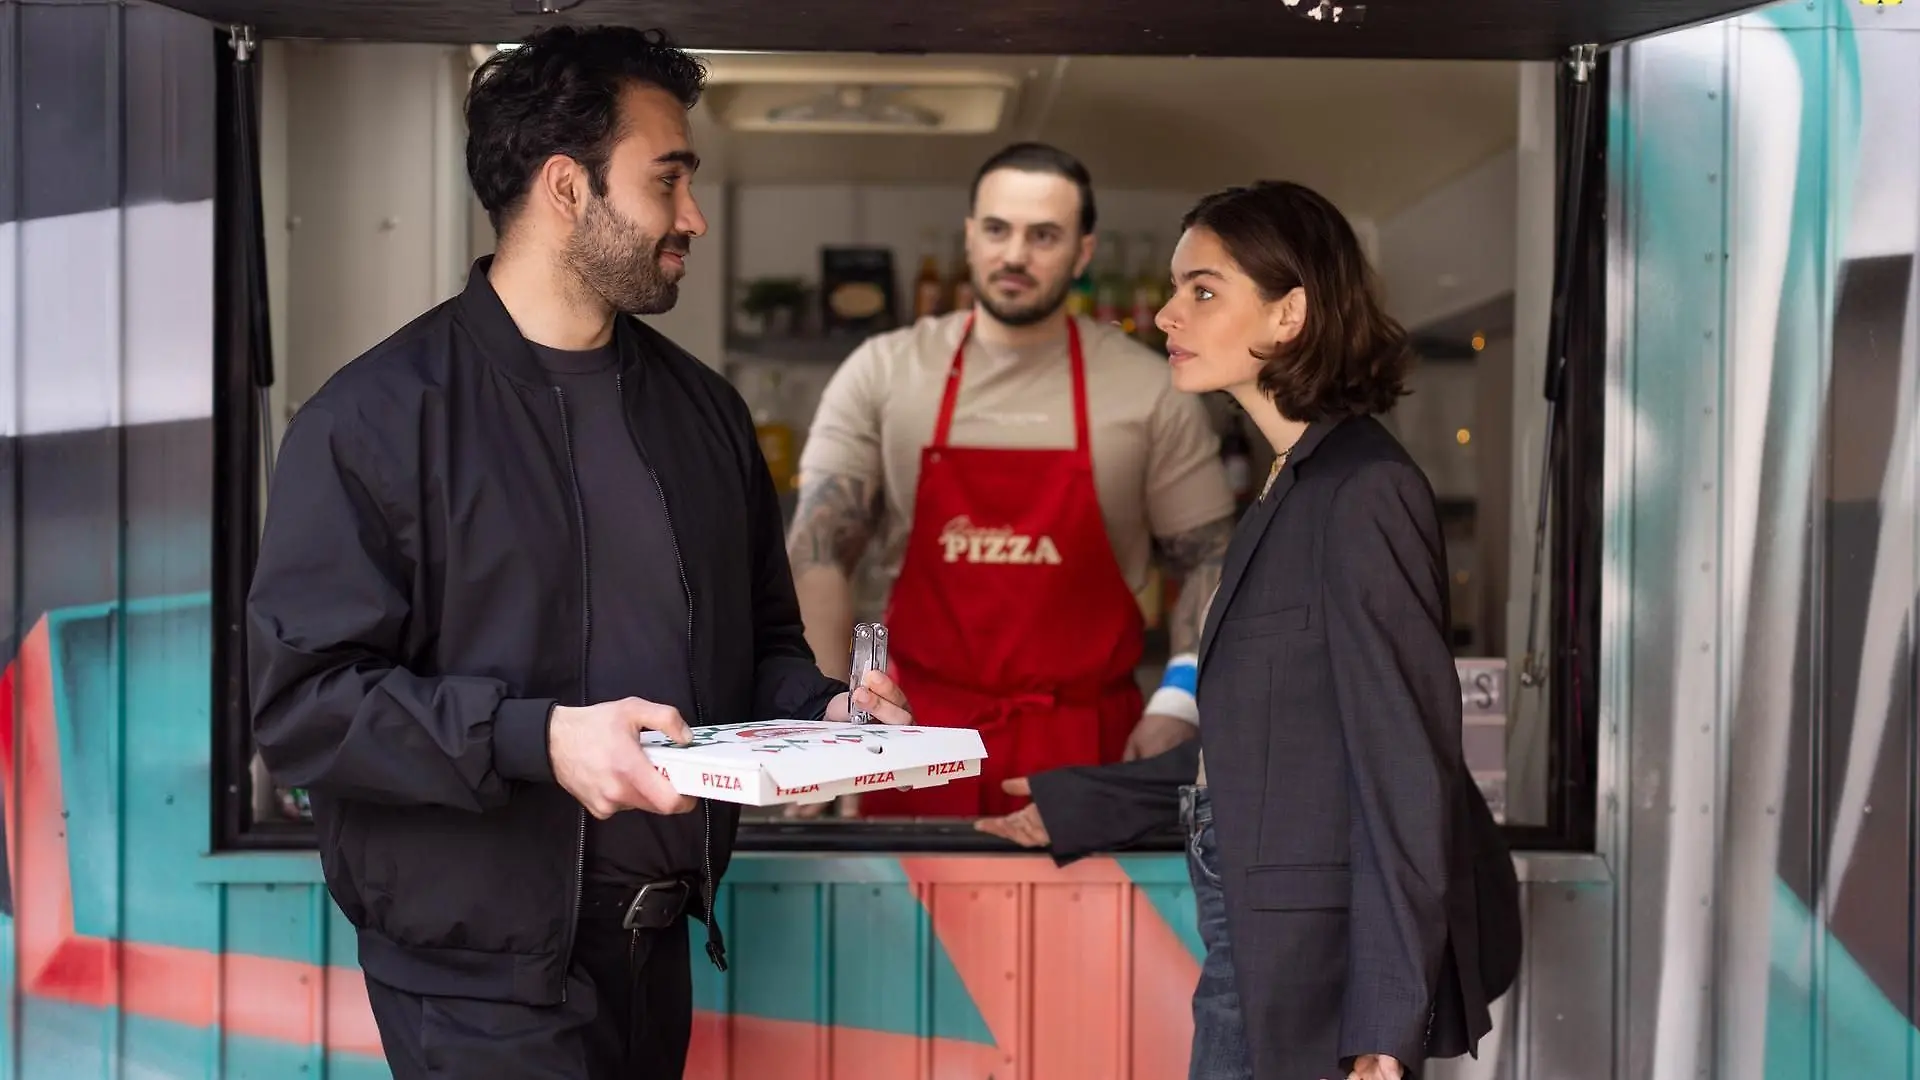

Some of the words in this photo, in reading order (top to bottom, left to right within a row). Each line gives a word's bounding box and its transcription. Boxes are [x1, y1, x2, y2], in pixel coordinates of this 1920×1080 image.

[944, 535, 1062, 564] PIZZA
[927, 760, 966, 776] PIZZA
[702, 773, 742, 791] PIZZA
[854, 771, 895, 786] PIZZA
